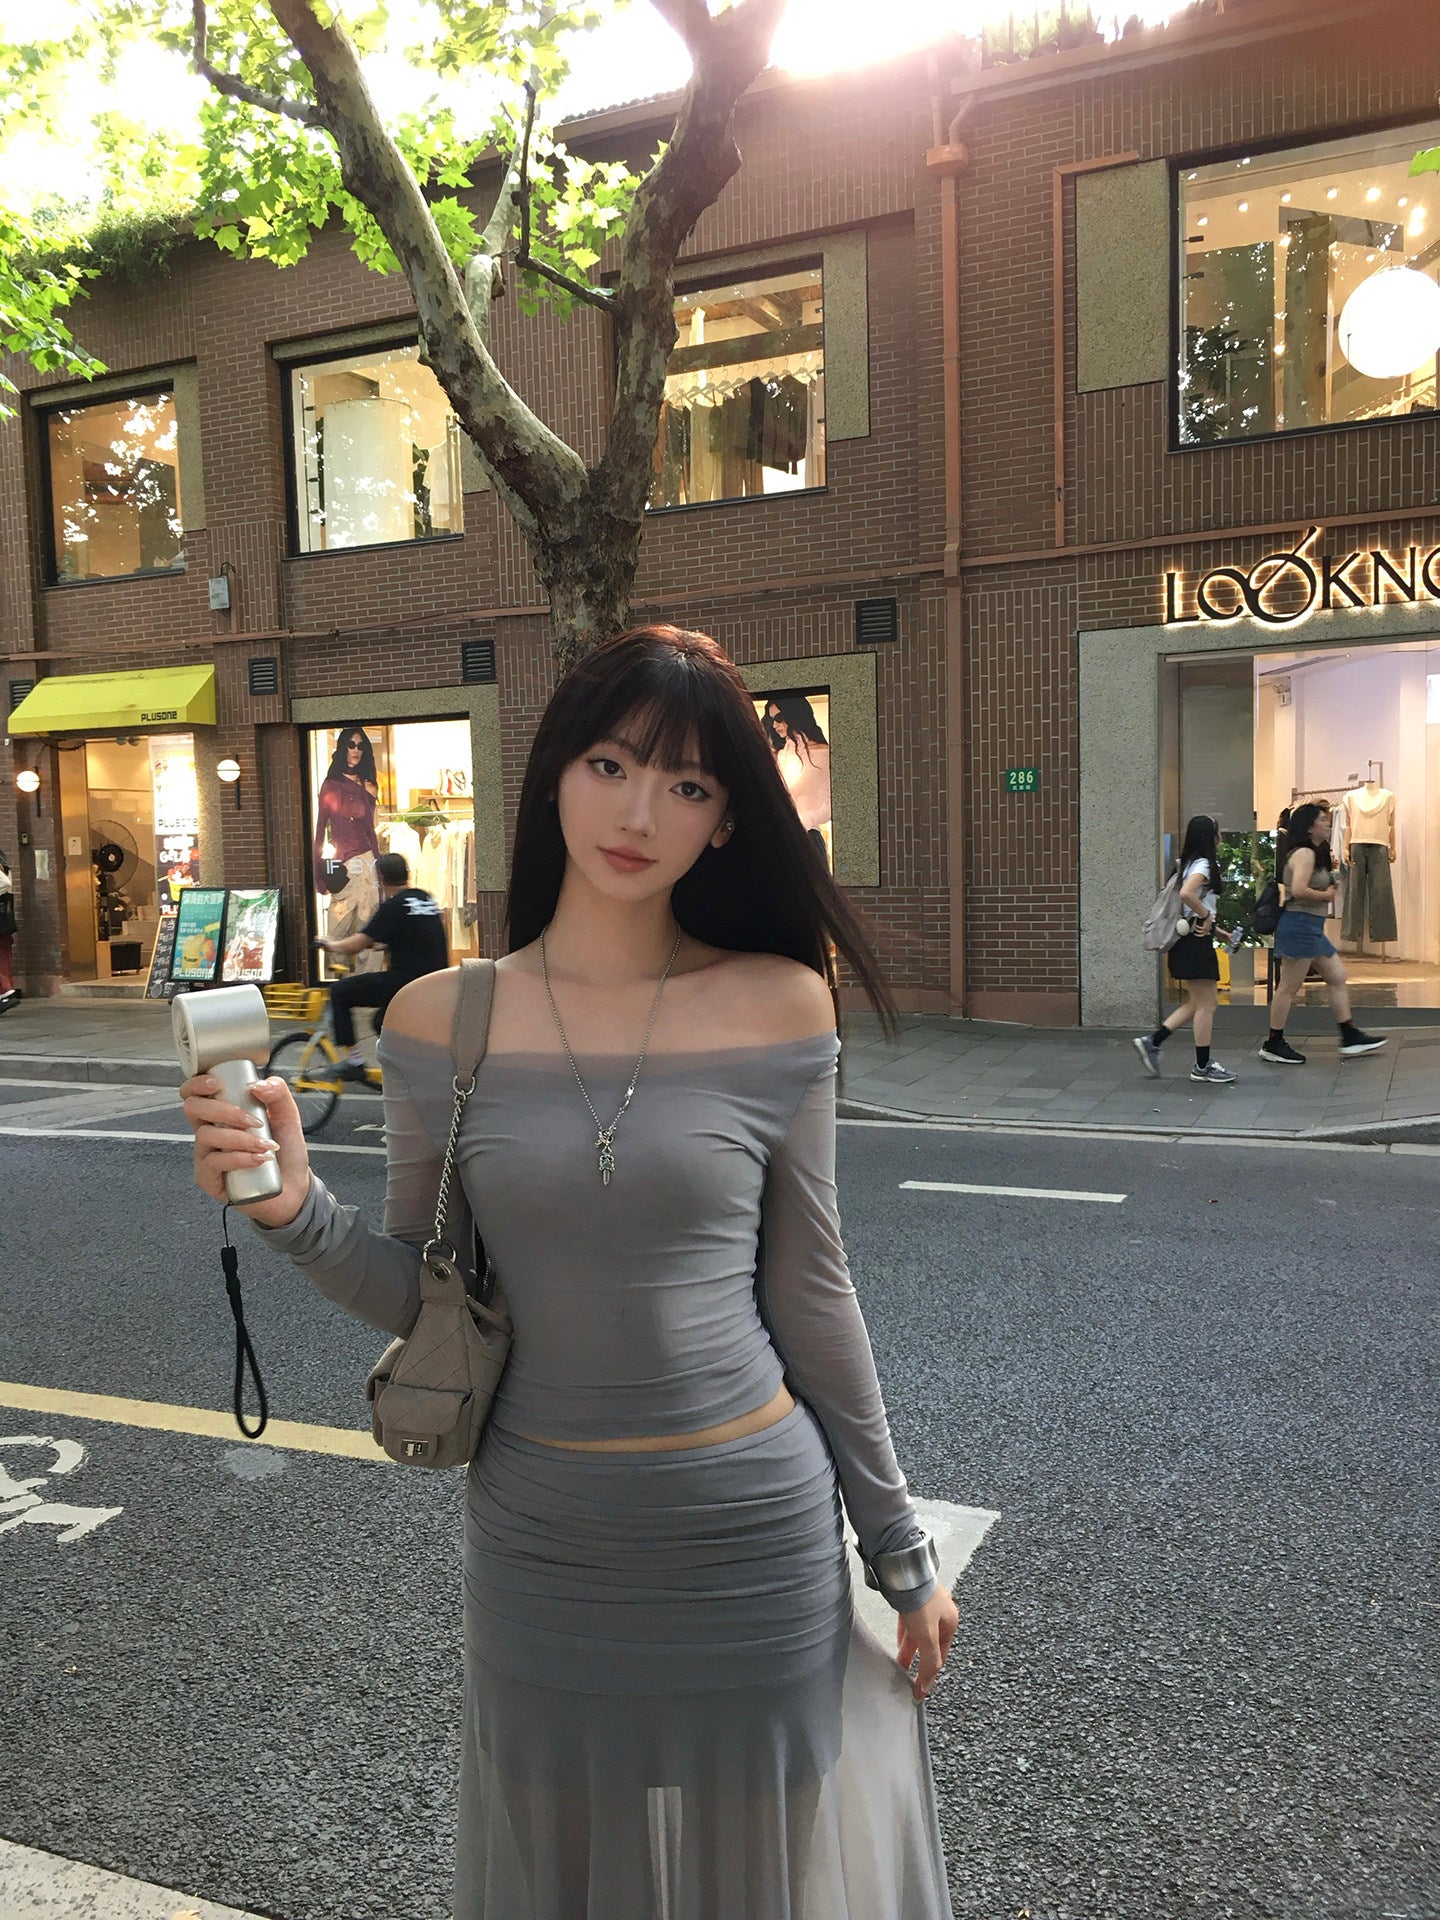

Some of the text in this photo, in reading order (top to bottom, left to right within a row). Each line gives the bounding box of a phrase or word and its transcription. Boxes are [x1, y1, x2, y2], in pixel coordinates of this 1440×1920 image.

[1010, 771, 1034, 785] 286
[326, 858, 378, 874] IF BY
[173, 967, 214, 980] PLUSONE
